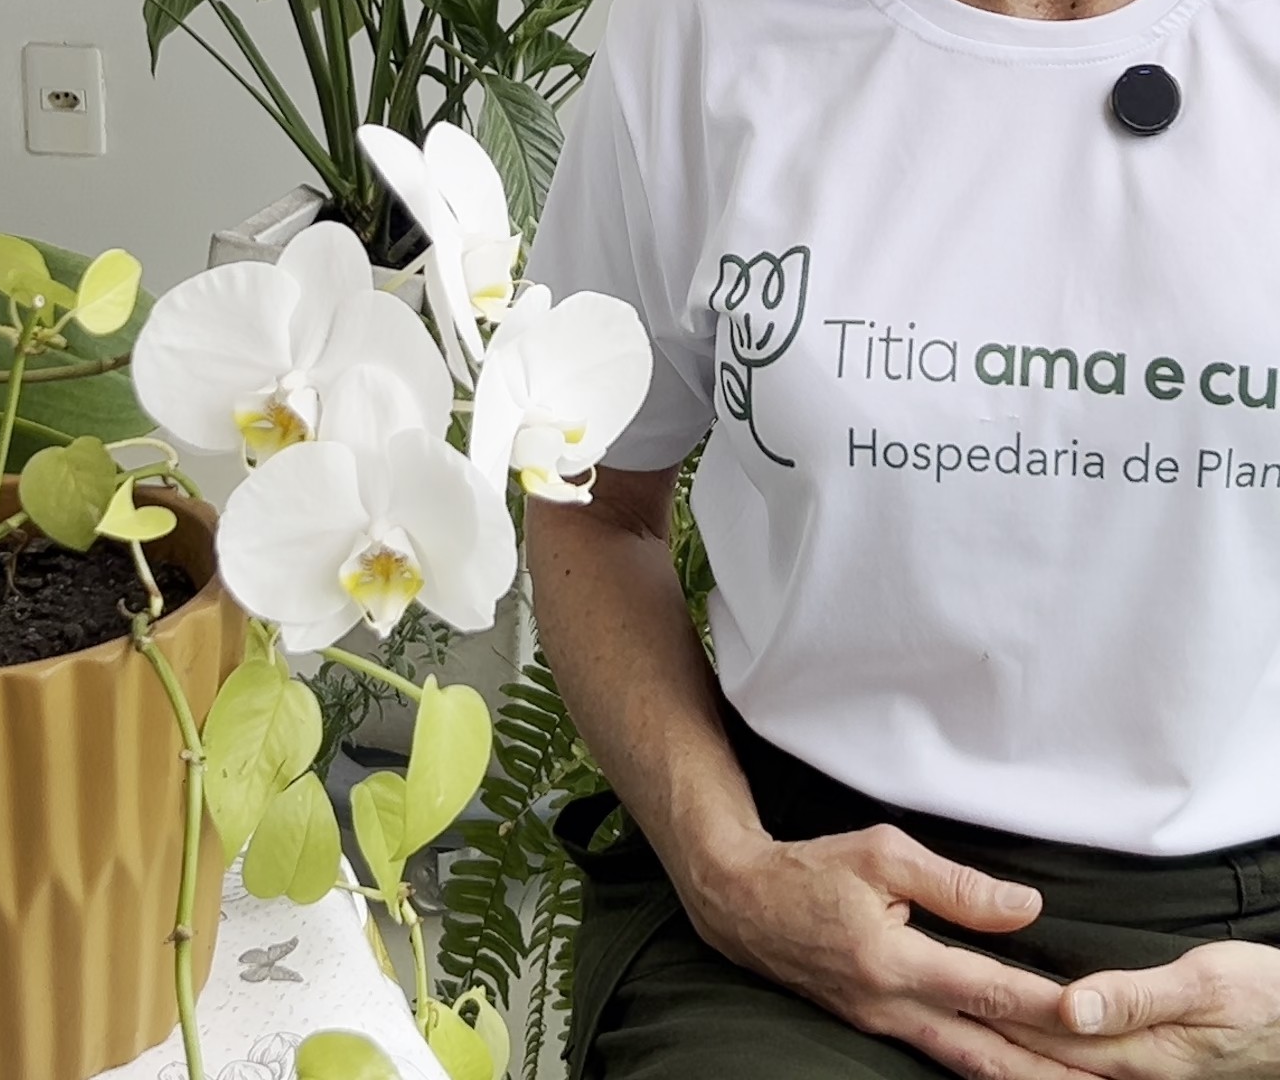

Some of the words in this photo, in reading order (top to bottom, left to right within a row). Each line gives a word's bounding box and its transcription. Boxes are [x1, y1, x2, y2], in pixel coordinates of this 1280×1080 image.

[823, 319, 958, 384] Titia
[974, 342, 1127, 397] ama
[1144, 356, 1186, 401] e
[848, 426, 1105, 484] Hospedaria
[1122, 441, 1180, 485] de
